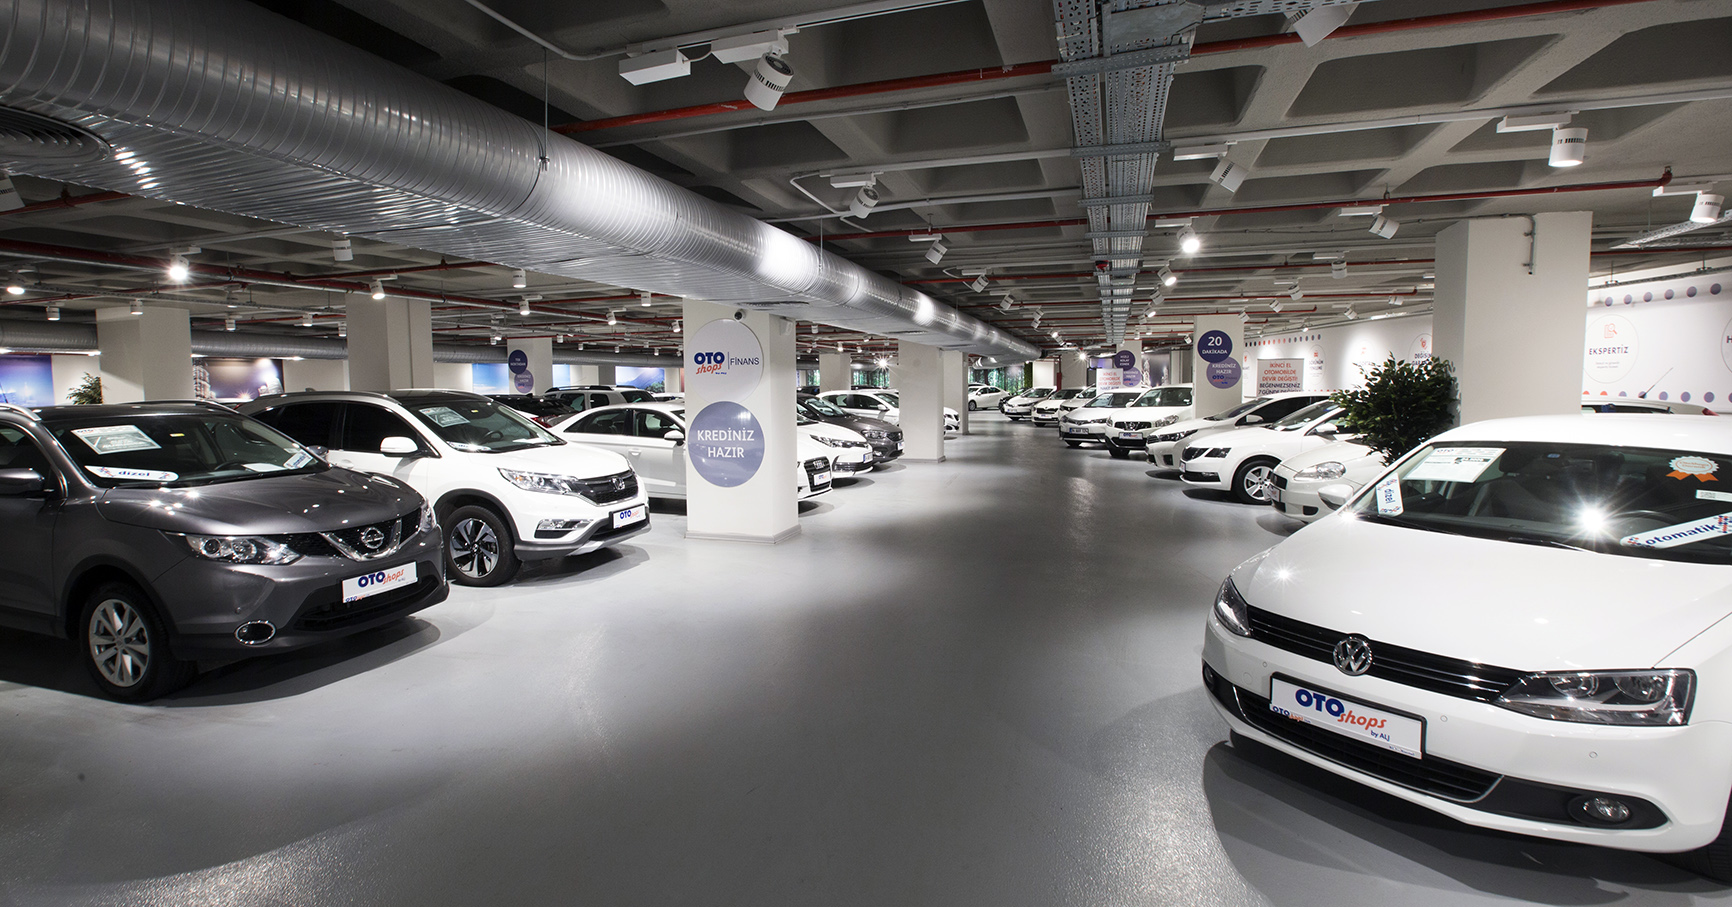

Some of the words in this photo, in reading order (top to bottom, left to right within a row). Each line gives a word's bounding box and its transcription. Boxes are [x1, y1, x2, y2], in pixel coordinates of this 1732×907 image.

[1207, 336, 1223, 346] 20
[1588, 344, 1629, 355] EKSPERTİZ
[693, 351, 725, 365] OTO
[730, 357, 760, 366] FİNANS
[695, 363, 723, 375] shops
[697, 428, 754, 442] KREDİNİZ
[708, 447, 744, 458] HAZIR
[1384, 488, 1396, 504] dizel
[620, 510, 632, 520] OTO
[1646, 524, 1720, 545] otomatik
[358, 571, 386, 588] OTO
[382, 568, 404, 584] shops
[1272, 706, 1290, 716] OTO
[1295, 688, 1345, 717] OTO
[1337, 710, 1388, 730] shops
[1370, 730, 1378, 738] by
[1379, 733, 1390, 742] ALJ
